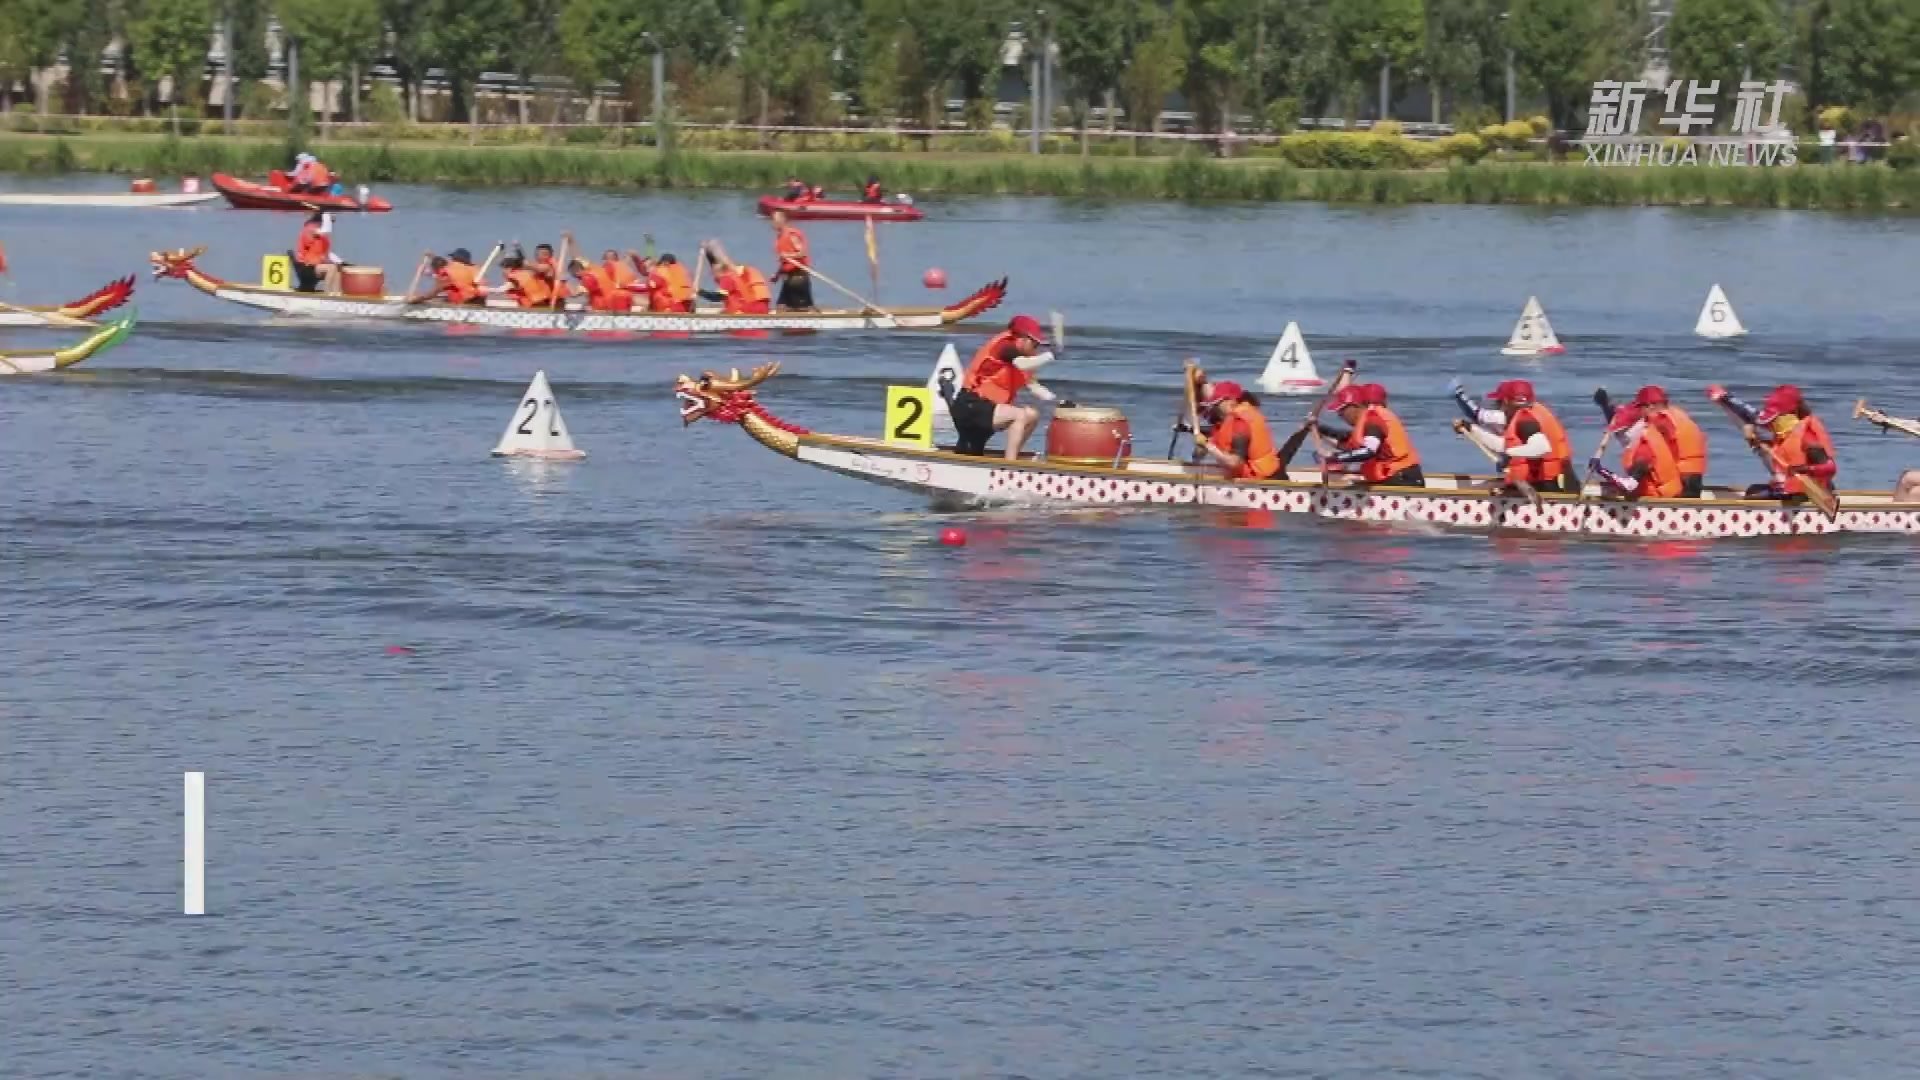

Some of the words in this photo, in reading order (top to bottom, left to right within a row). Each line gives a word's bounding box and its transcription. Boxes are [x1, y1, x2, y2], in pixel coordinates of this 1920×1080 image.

[269, 261, 284, 285] 6
[1710, 301, 1726, 323] 6
[1280, 341, 1300, 368] 4
[894, 395, 923, 439] 2
